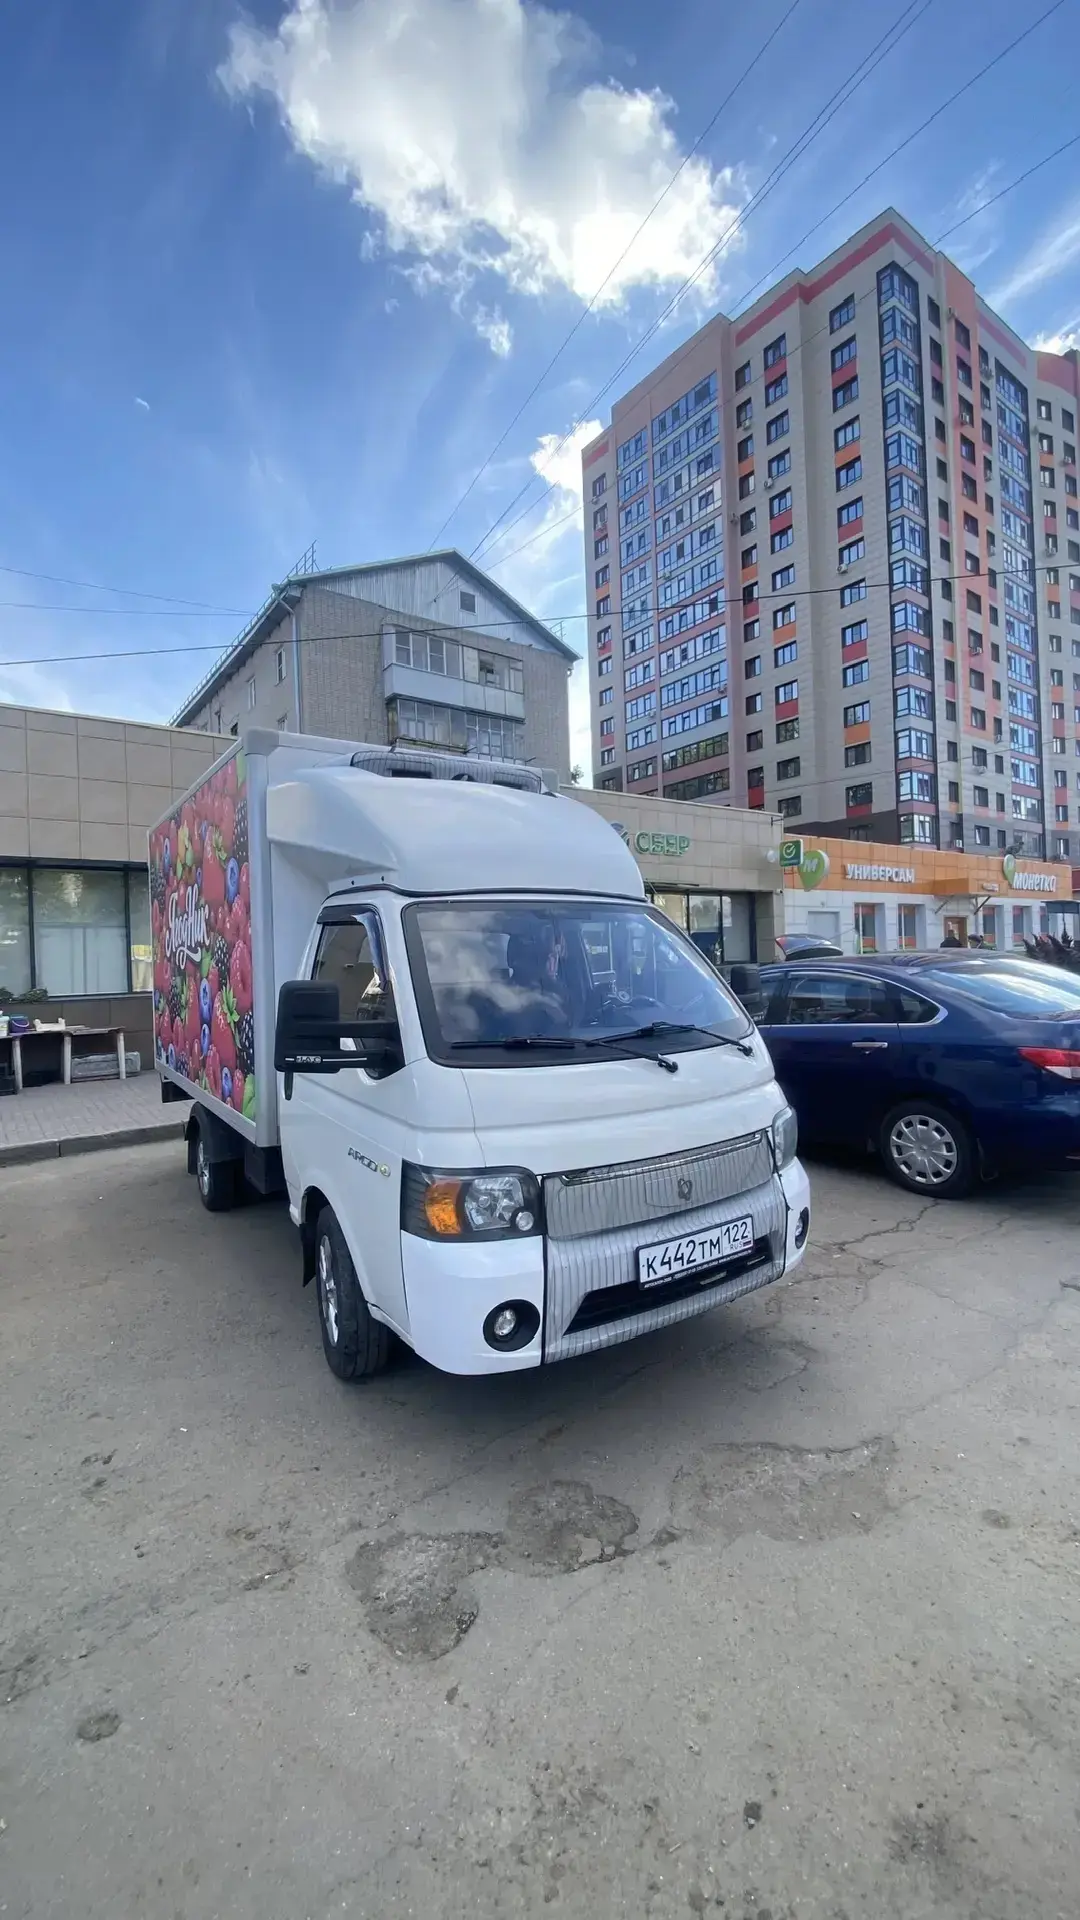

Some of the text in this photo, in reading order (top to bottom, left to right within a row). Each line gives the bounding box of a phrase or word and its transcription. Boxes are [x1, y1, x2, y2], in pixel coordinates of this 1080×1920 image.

[845, 863, 915, 883] УНИВЕРСАМ
[646, 1236, 721, 1278] К442ТМ
[724, 1221, 749, 1244] 122
[730, 1241, 743, 1250] RUS
